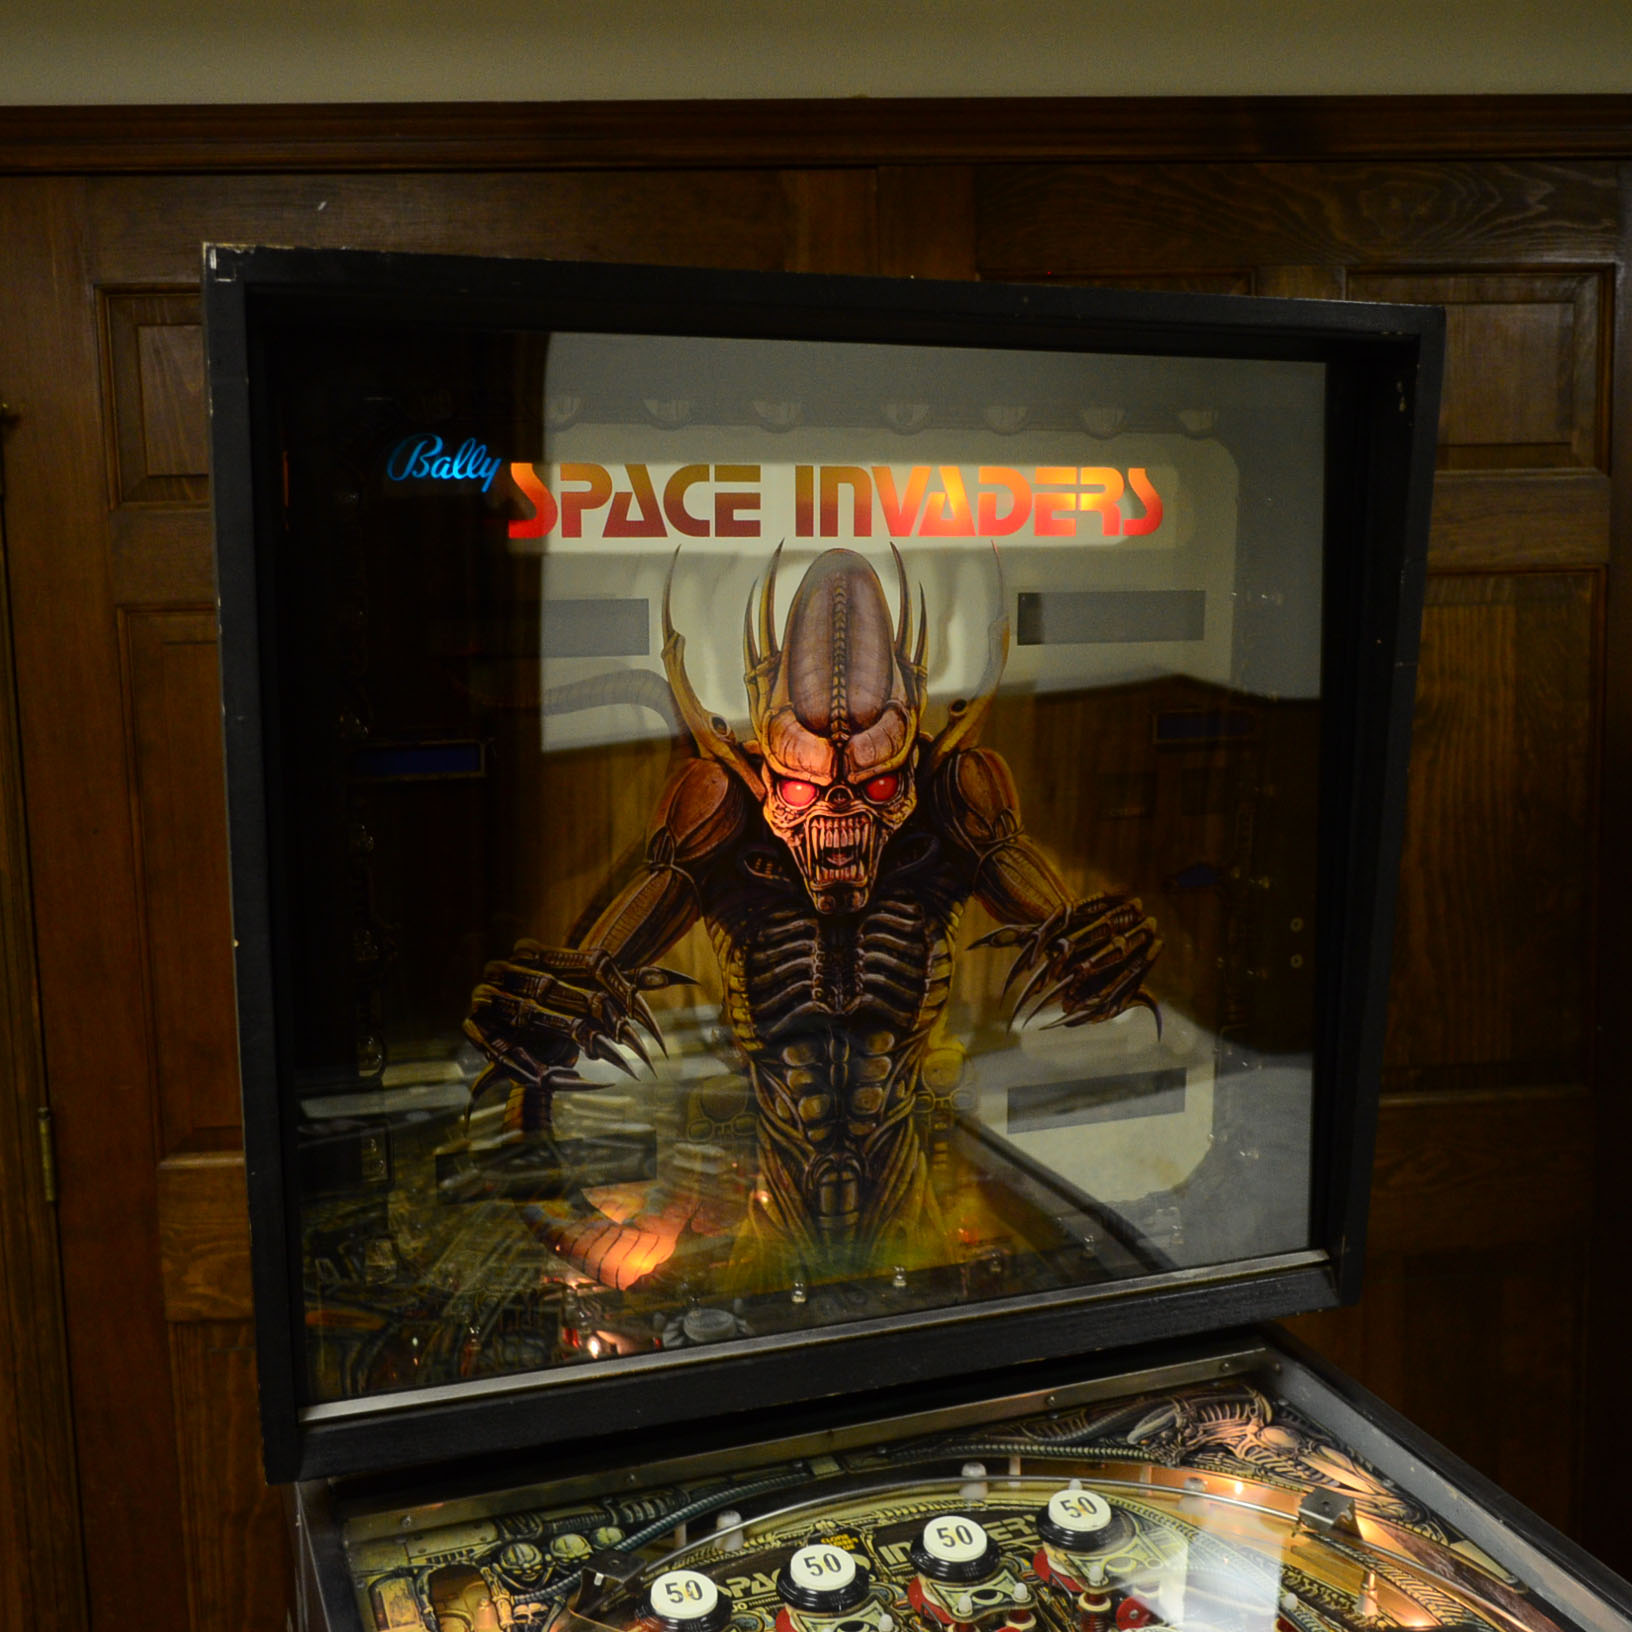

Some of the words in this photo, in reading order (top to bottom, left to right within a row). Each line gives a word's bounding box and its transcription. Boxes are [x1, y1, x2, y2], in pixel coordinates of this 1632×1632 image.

[386, 432, 502, 493] Bally
[507, 461, 762, 539] SPACE
[794, 464, 1164, 538] INVADERS
[1059, 1495, 1098, 1519] 50
[935, 1524, 974, 1548] 50
[803, 1552, 842, 1577] 50
[664, 1579, 703, 1604] 50
